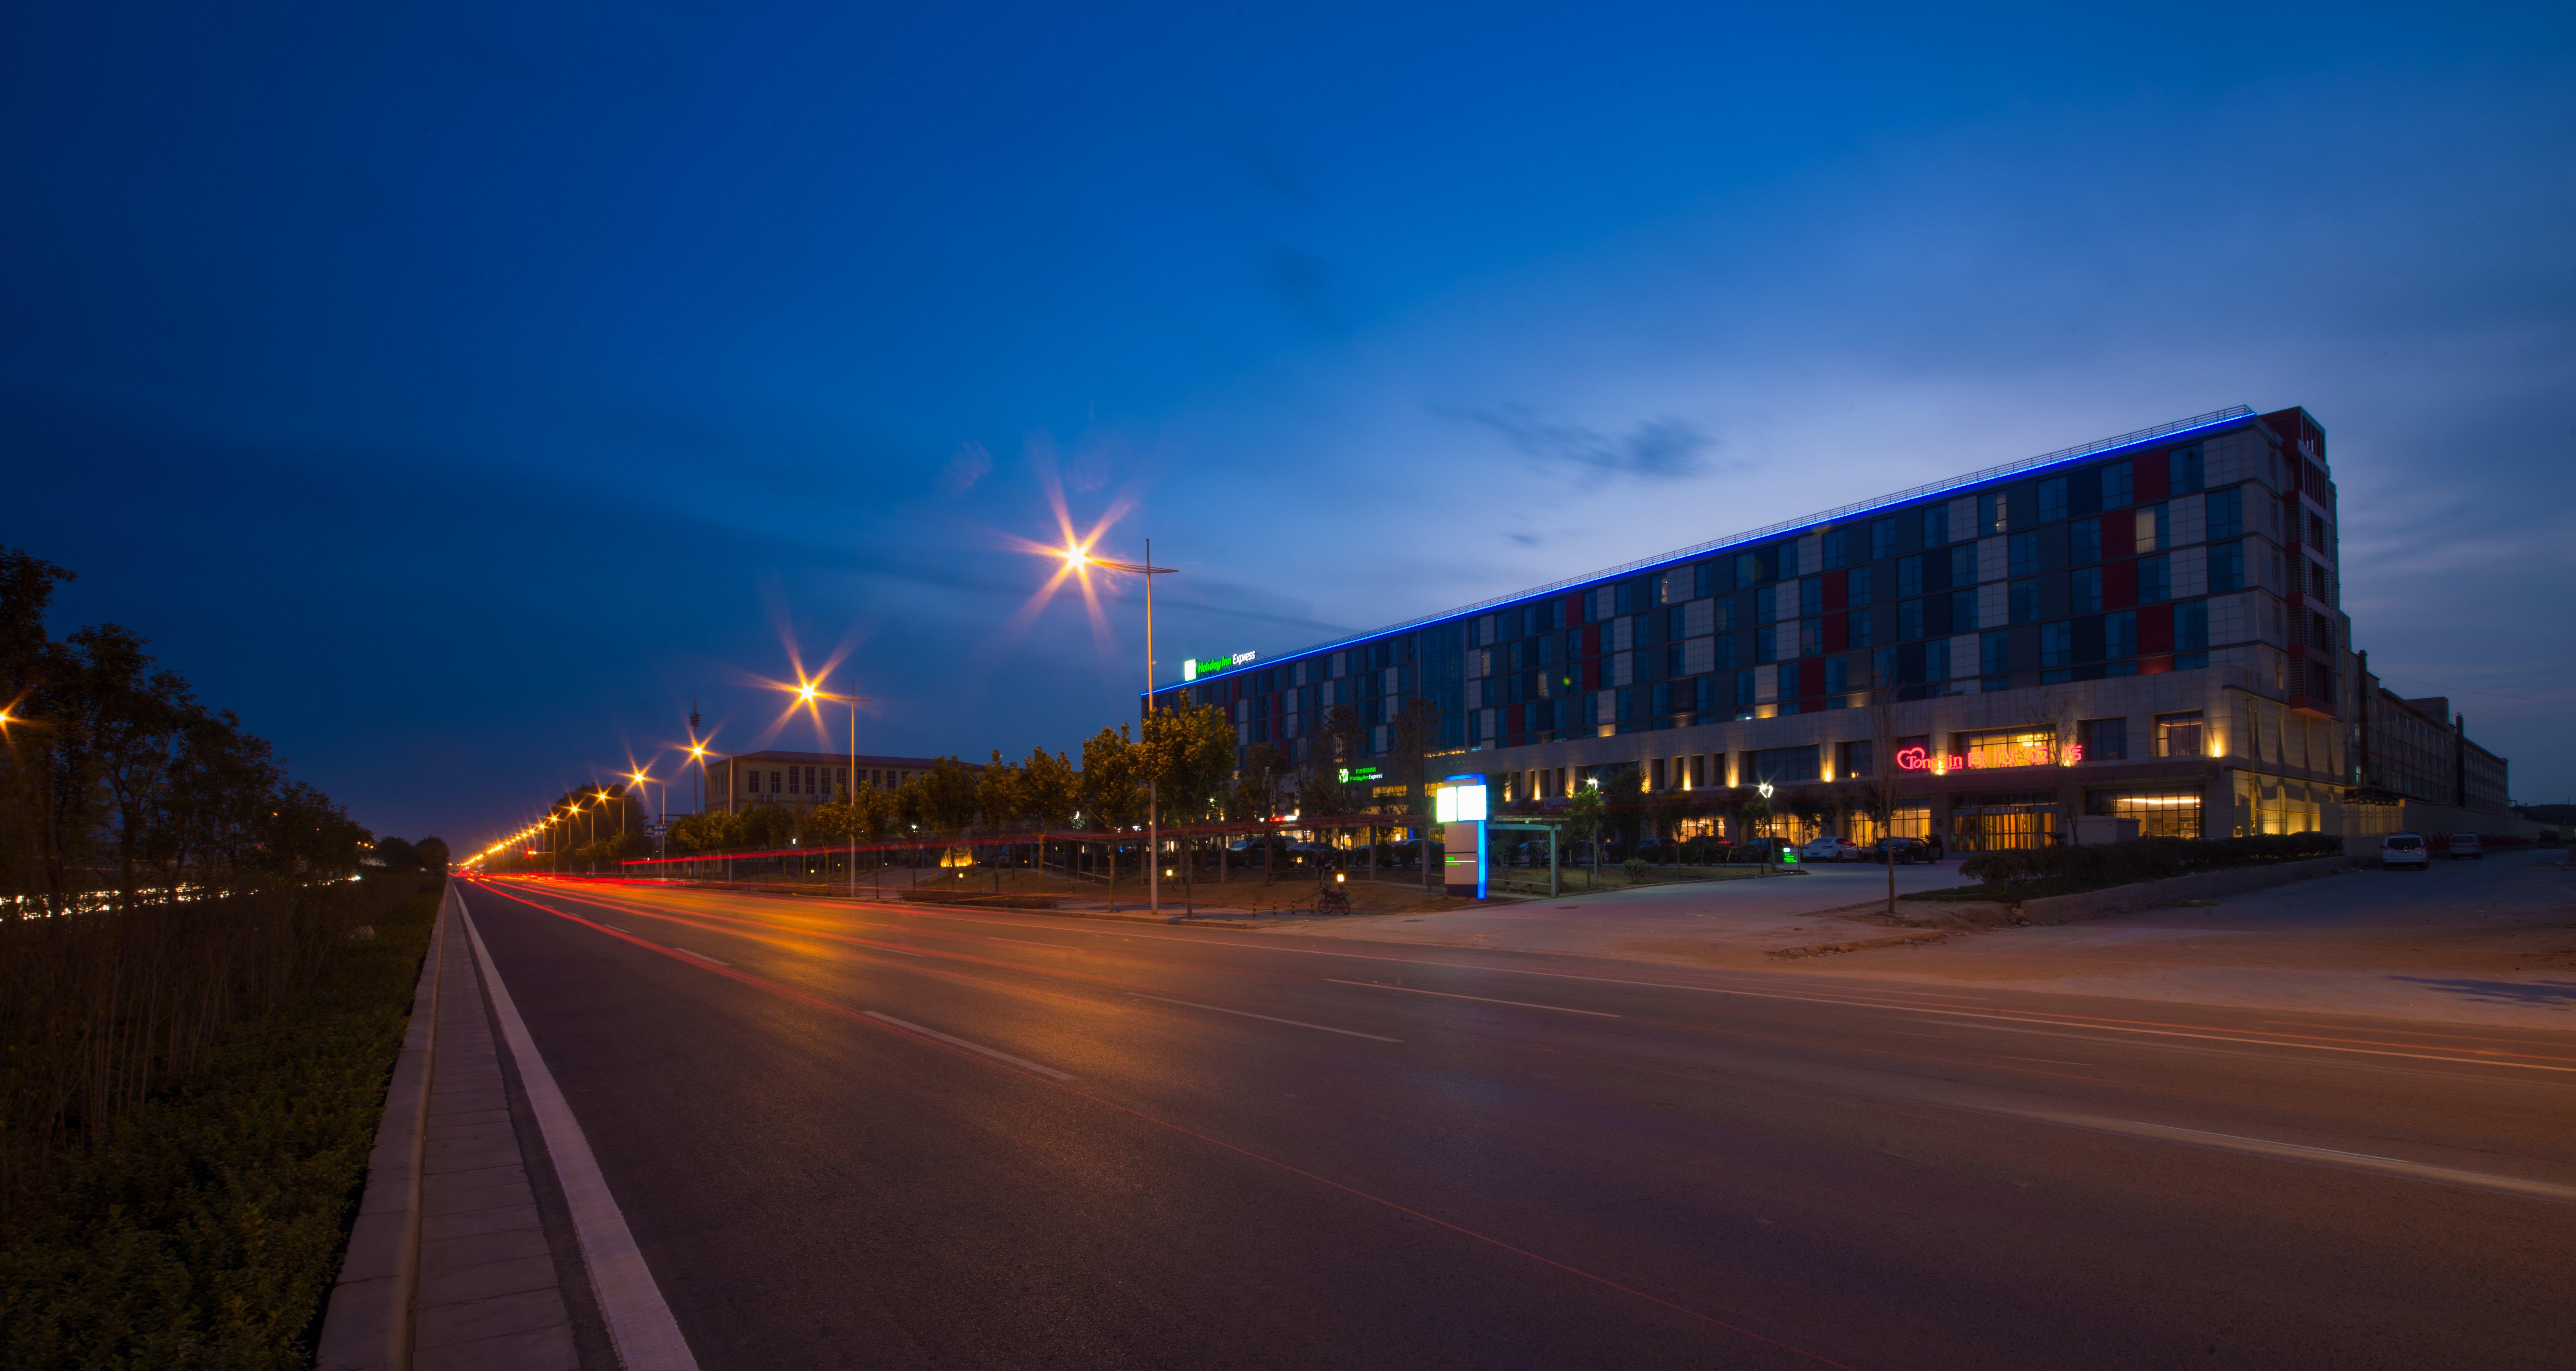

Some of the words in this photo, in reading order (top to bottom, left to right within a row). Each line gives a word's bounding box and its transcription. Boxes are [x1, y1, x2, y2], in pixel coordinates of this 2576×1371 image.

[1198, 659, 1222, 673] Holiday
[1222, 655, 1232, 667] Inn
[1232, 651, 1256, 665] Express
[1967, 745, 2082, 768] 同心饭店
